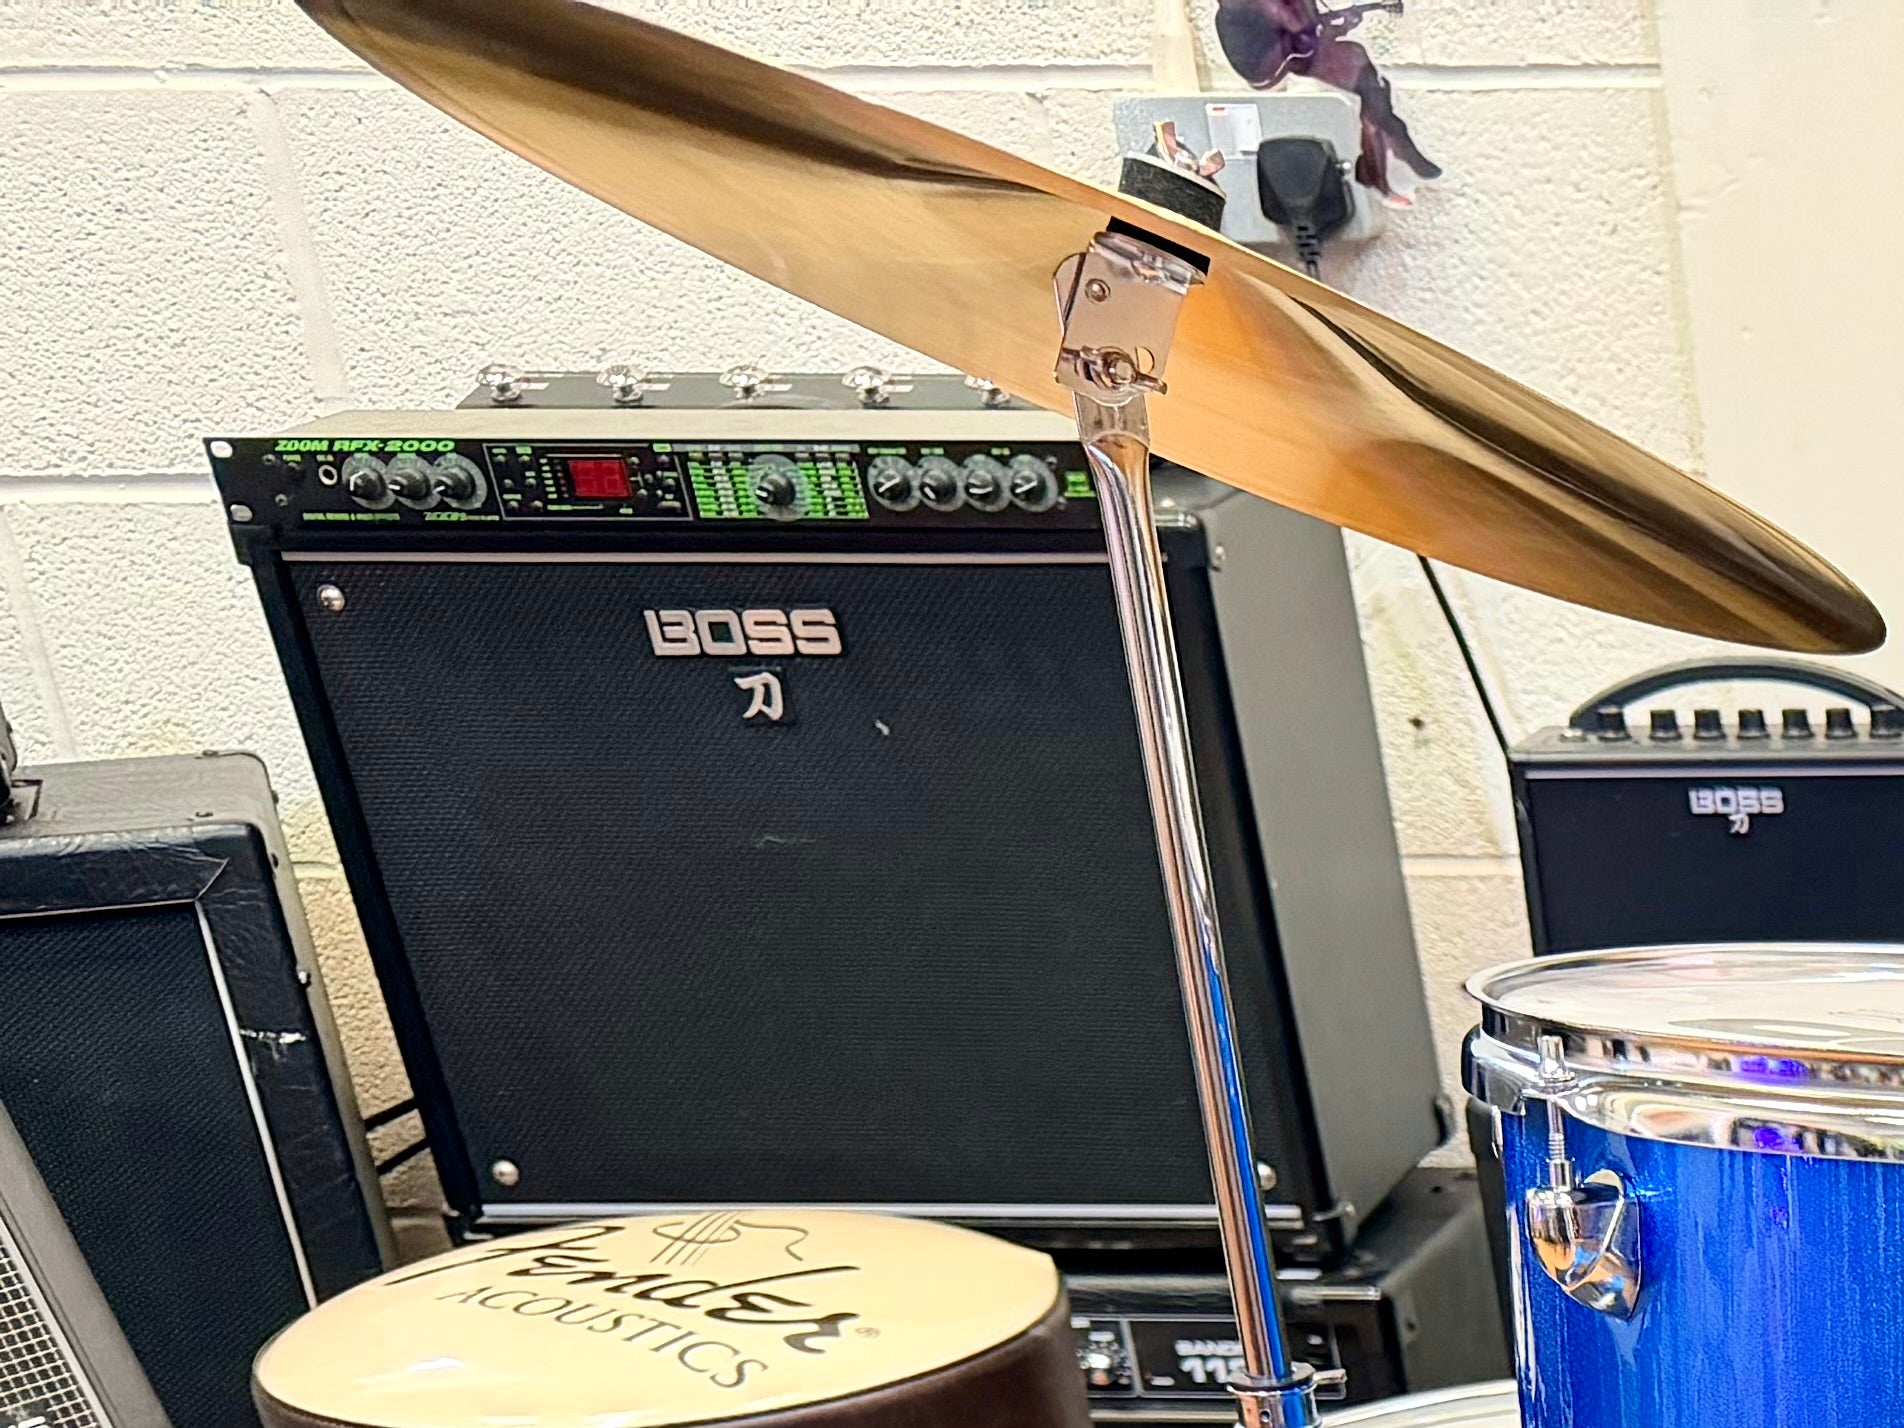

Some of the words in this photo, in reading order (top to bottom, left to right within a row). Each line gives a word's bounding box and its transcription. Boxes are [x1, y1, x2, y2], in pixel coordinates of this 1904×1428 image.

[275, 440, 329, 452] ZOOM
[333, 440, 456, 452] RFX-2000
[643, 608, 843, 656] BOSS
[1688, 787, 1785, 815] BOSS
[383, 1226, 860, 1354] Fender
[436, 1285, 768, 1389] ACOUSTICS
